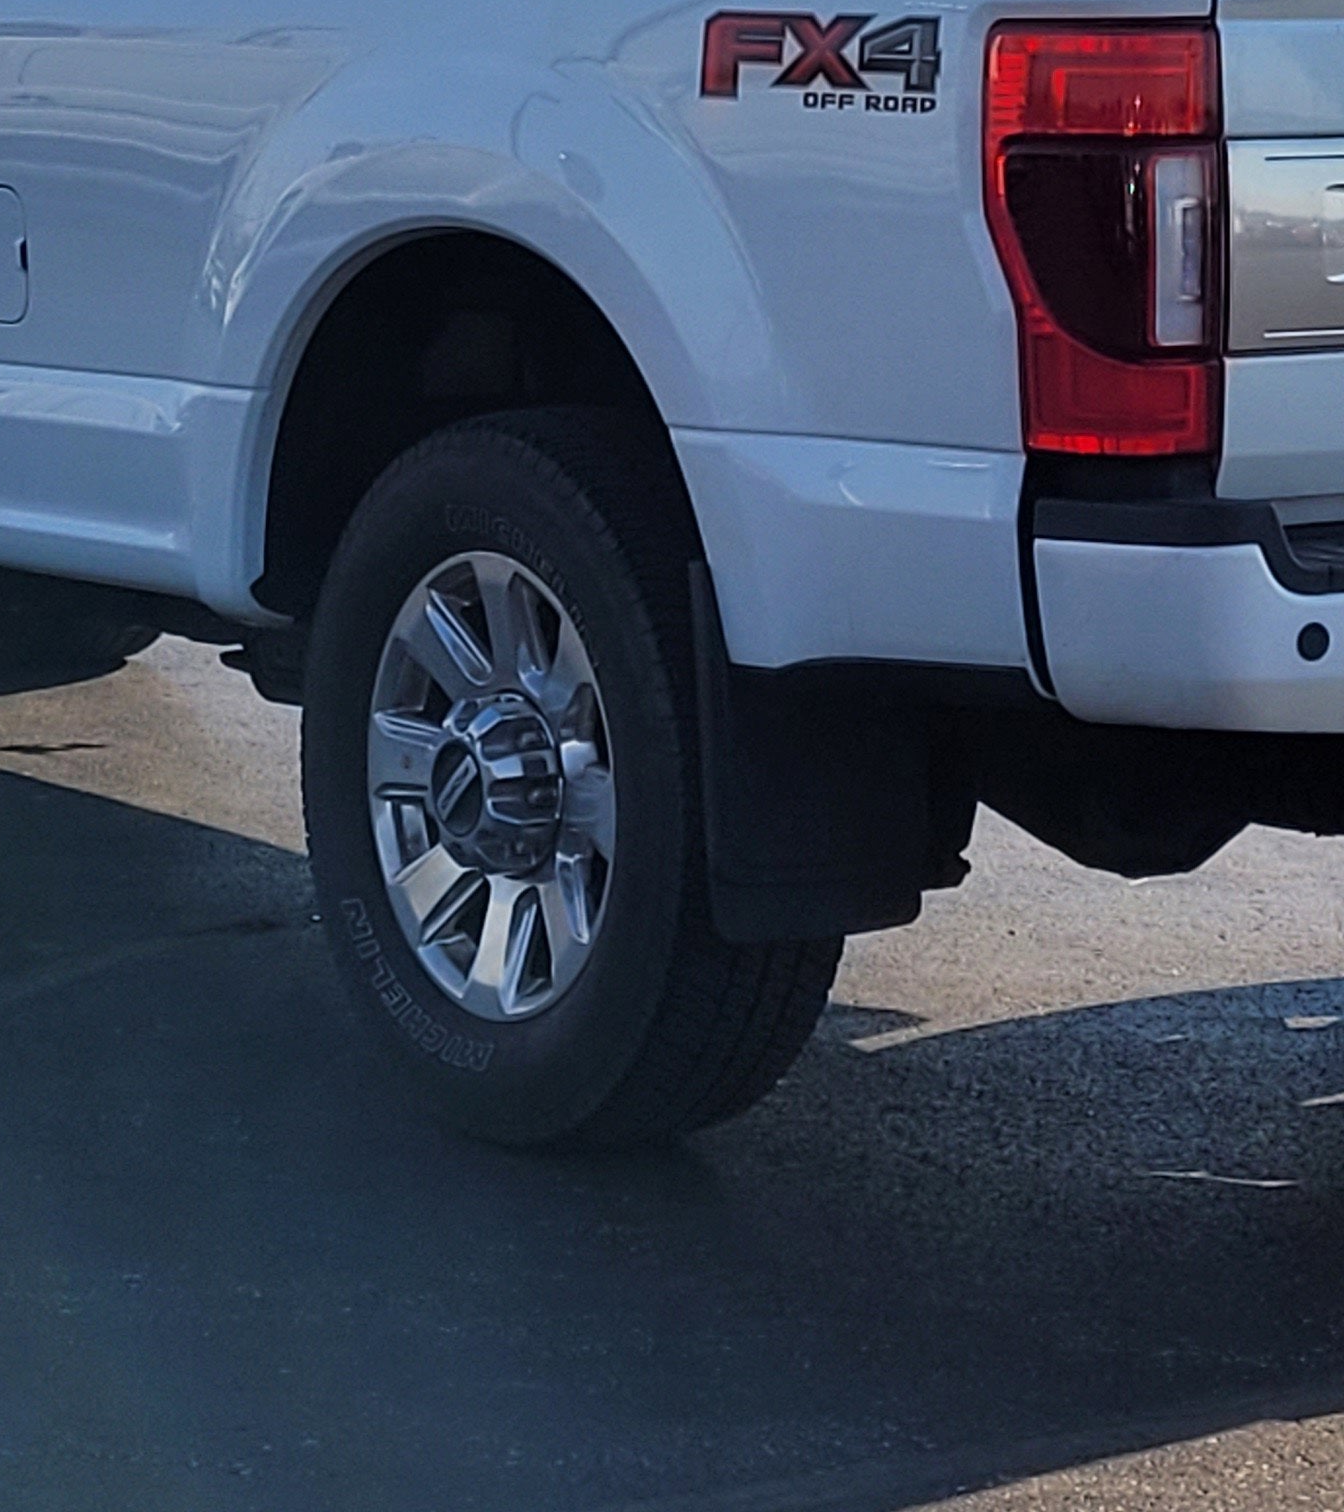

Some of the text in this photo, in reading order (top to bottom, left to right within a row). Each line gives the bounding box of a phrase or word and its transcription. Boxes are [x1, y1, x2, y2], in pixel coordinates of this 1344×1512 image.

[700, 9, 942, 99] FX4
[802, 92, 937, 113] OFF ROAD
